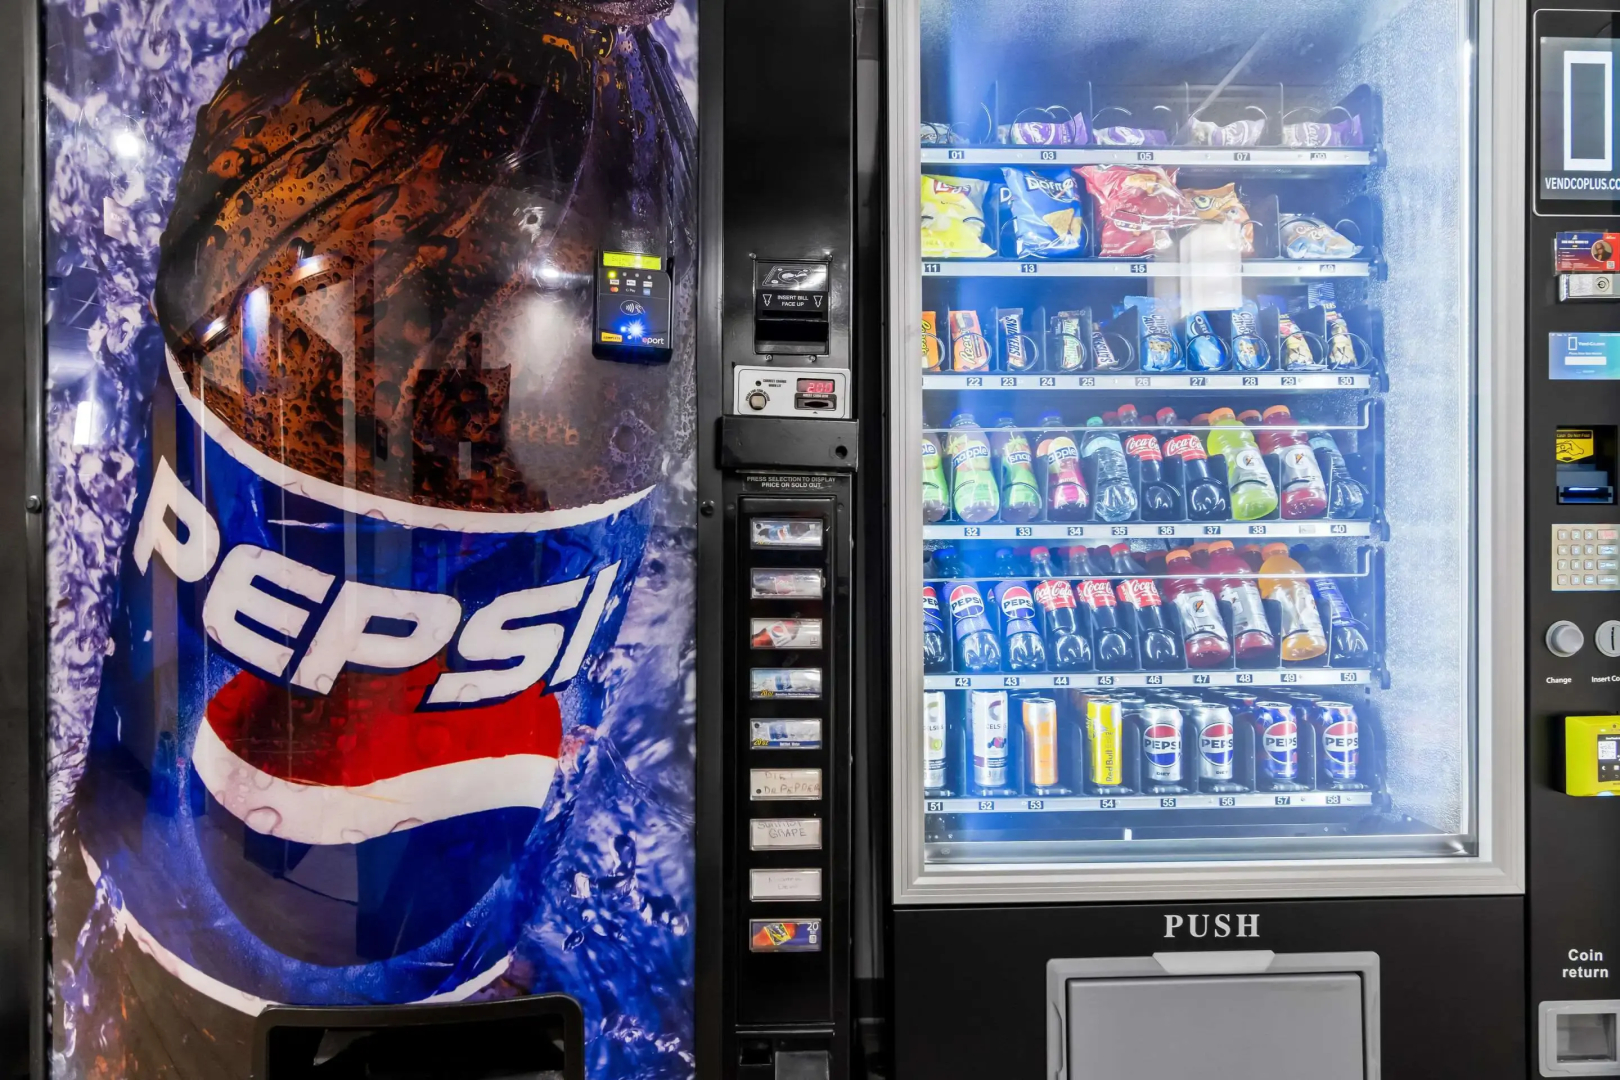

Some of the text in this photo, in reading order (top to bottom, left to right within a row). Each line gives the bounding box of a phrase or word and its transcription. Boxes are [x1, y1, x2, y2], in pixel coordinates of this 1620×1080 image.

[951, 151, 962, 159] 01
[1042, 151, 1054, 160] 03
[1140, 151, 1152, 160] 05
[1236, 153, 1248, 161] 07
[1545, 178, 1620, 190] VENDCOPLUS.CO
[926, 264, 938, 272] 11
[1023, 264, 1035, 272] 13
[642, 336, 665, 344] eport
[968, 377, 981, 386] 22
[1002, 377, 1014, 386] 23
[1042, 377, 1054, 386] 24
[1082, 377, 1094, 386] 25
[1137, 377, 1149, 386] 26
[1192, 377, 1204, 386] 27
[1245, 377, 1257, 386] 28
[1283, 377, 1295, 385] 29
[1340, 377, 1352, 385] 30
[966, 528, 978, 536] 32
[1019, 528, 1031, 536] 33
[1069, 527, 1081, 535] 34
[1113, 527, 1126, 535] 35
[1160, 526, 1173, 535] 36
[1207, 526, 1219, 534] 37
[1252, 526, 1264, 534] 38
[1333, 525, 1345, 533] 40
[134, 455, 620, 704] PEPSI
[1006, 677, 1018, 686] 43
[1056, 677, 1068, 685] 44
[1100, 676, 1112, 685] 45
[1148, 675, 1160, 684] 46
[1195, 675, 1208, 683] 47
[1239, 674, 1251, 683] 48
[1283, 674, 1296, 682] 49
[1343, 673, 1355, 681] 50
[1546, 677, 1572, 685] Change
[956, 678, 969, 686] 42
[1145, 738, 1181, 750] PEPSI
[1105, 749, 1114, 766] Bull
[1105, 766, 1114, 782] Red
[1102, 800, 1114, 808] 54
[1162, 798, 1174, 807] 55
[1221, 797, 1234, 806] 56
[1277, 796, 1289, 804] 57
[1327, 796, 1339, 804] 58
[930, 802, 941, 811] 51
[980, 802, 992, 810] 52
[1030, 801, 1042, 809] 53
[769, 828, 807, 838] GRAPE
[807, 922, 819, 931] 20
[1163, 913, 1260, 938] PUSH
[1568, 948, 1603, 961] Coin
[1562, 966, 1609, 978] return
